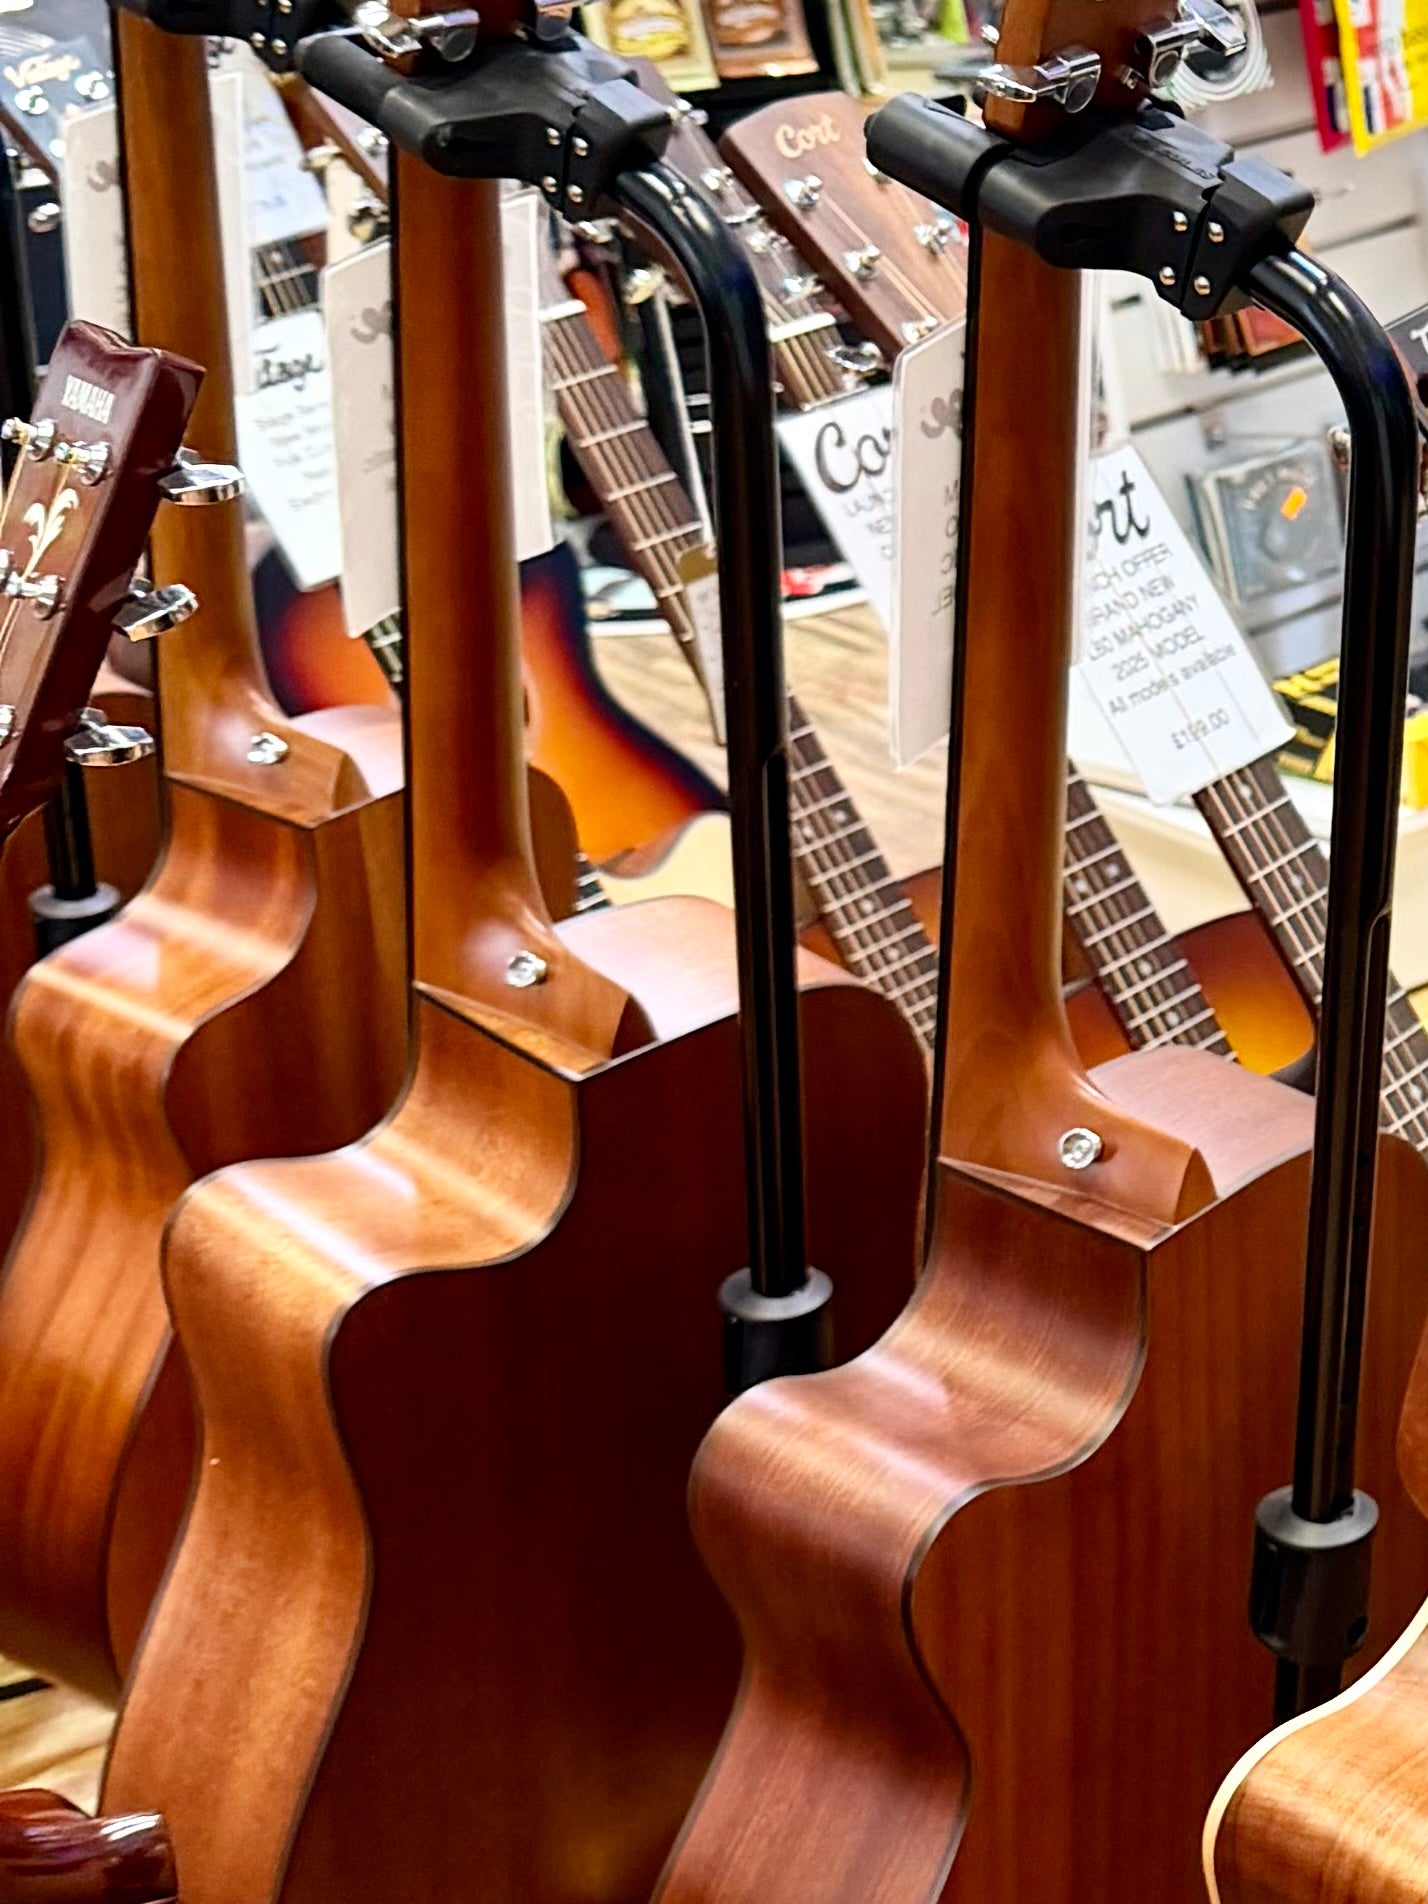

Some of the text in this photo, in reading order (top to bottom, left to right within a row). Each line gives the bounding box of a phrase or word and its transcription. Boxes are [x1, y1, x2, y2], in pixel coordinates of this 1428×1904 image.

[775, 111, 841, 160] Cort
[61, 374, 117, 424] YAMAHA
[815, 420, 891, 495] Co
[1121, 542, 1174, 578] OFFER
[1113, 594, 1199, 646] MAHOGANY
[1111, 625, 1206, 682] 2025 MODEL
